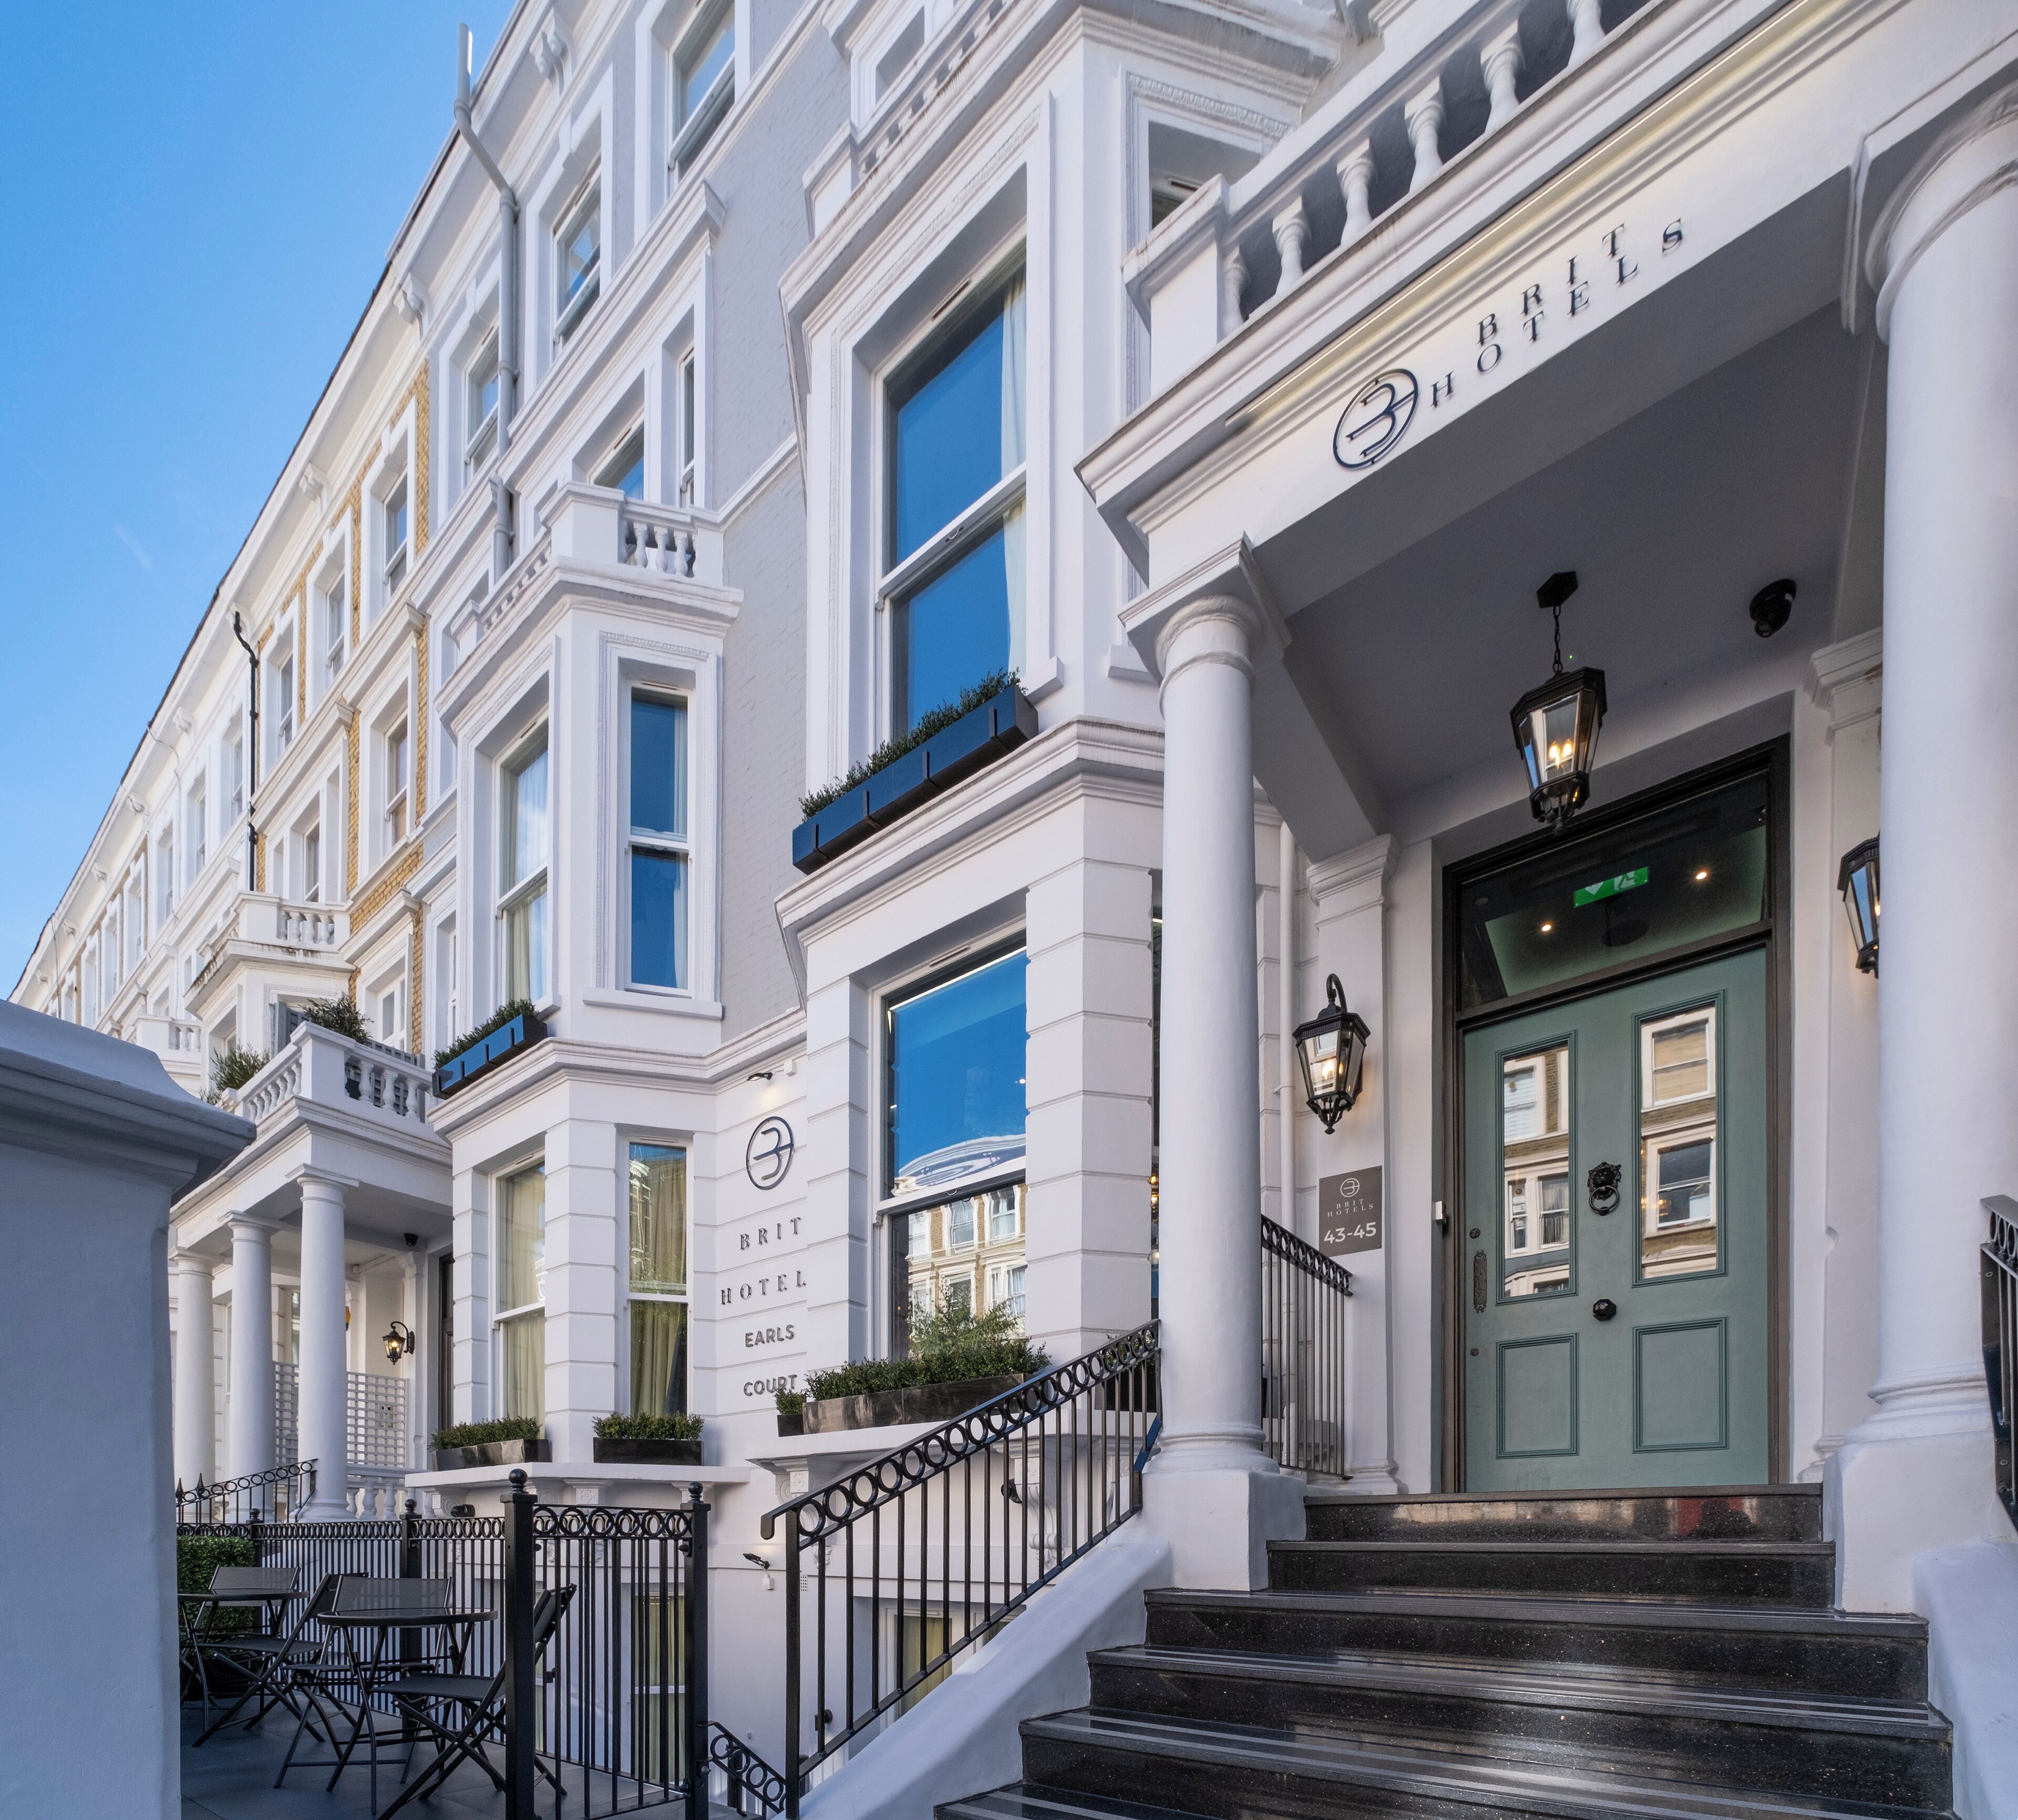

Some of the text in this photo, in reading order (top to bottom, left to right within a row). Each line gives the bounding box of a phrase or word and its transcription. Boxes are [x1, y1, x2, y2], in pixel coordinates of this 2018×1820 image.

[1476, 223, 1625, 346] BRIT
[1429, 218, 1683, 408] HOTELS
[1327, 1203, 1374, 1218] HOTELS
[1336, 1198, 1364, 1209] BRIT
[739, 1216, 801, 1251] BRIT
[1324, 1222, 1377, 1244] 43-45
[720, 1269, 807, 1306] HOTEL
[745, 1324, 795, 1348] EARLS
[743, 1374, 798, 1397] COURT
